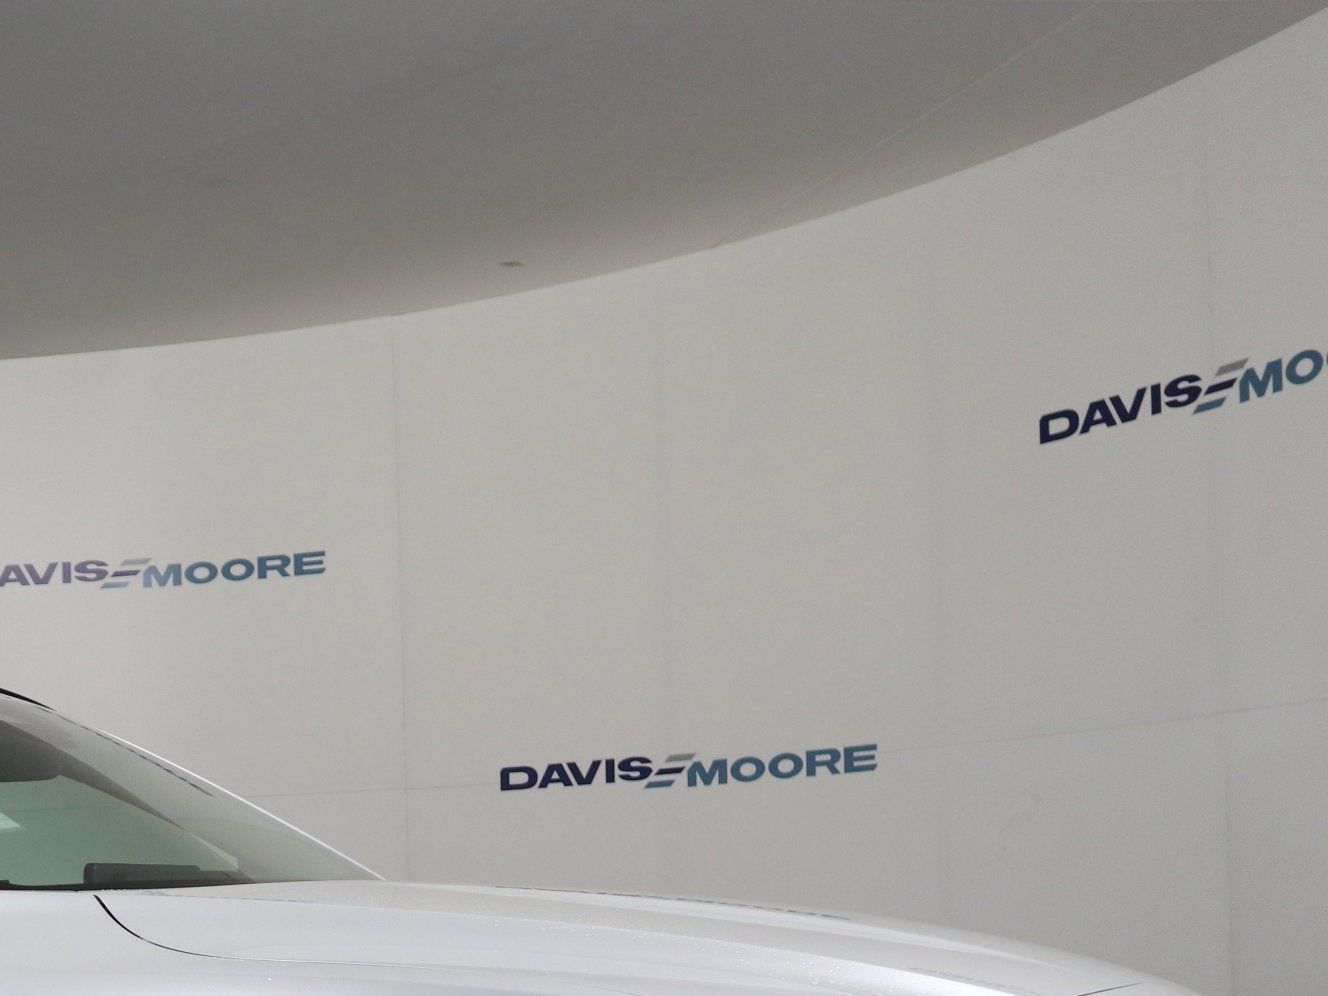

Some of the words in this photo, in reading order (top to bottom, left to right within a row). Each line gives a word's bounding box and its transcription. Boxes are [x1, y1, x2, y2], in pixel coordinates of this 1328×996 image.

[1039, 374, 1203, 445] DAVIS
[1239, 349, 1328, 404] MO
[142, 550, 326, 588] MOORE
[500, 756, 653, 792] DAVIS
[687, 743, 878, 787] MOORE
